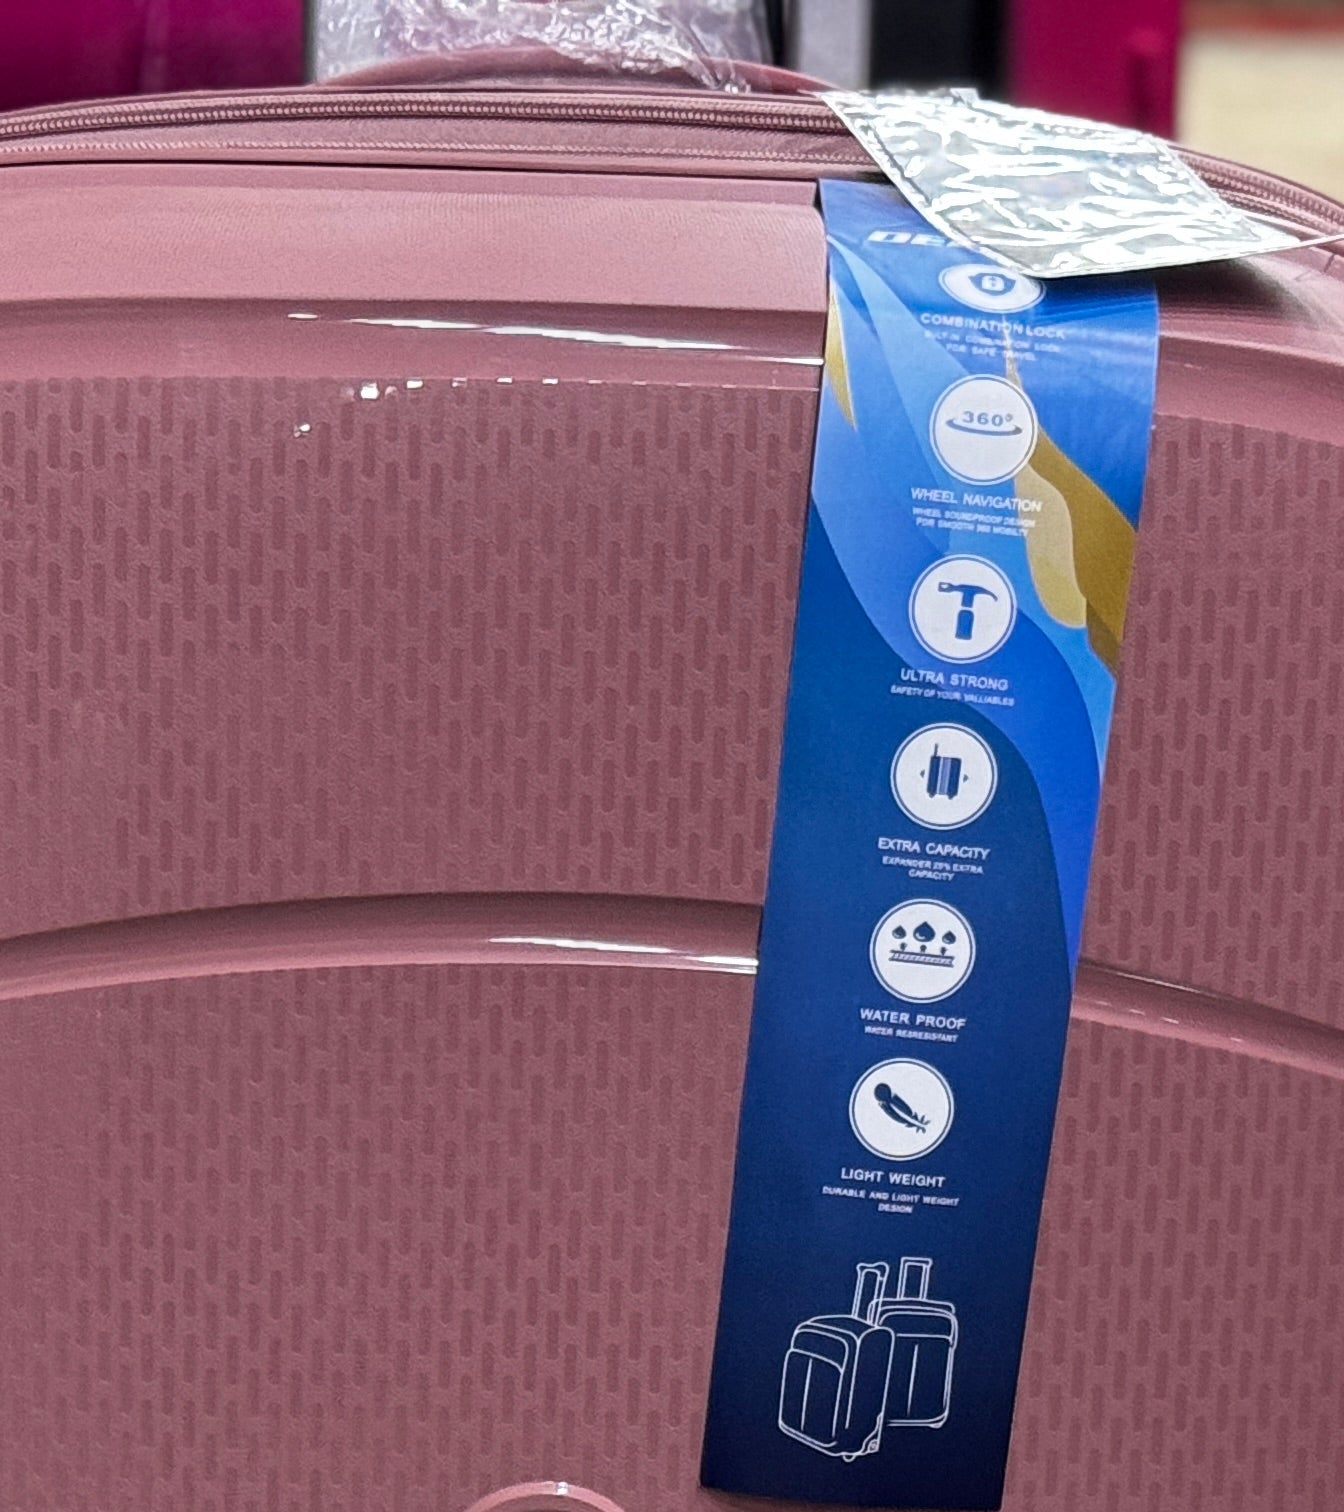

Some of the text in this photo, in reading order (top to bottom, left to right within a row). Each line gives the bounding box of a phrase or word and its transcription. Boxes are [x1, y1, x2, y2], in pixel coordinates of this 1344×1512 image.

[920, 312, 1066, 340] COMBINATION LOCK
[911, 487, 1043, 512] WHEEL NAVIGATION
[916, 516, 935, 527] FOR
[900, 667, 1009, 691] ULTRA STRONG
[890, 684, 923, 697] SAFETY
[924, 688, 936, 698] OF
[937, 690, 962, 701] YOUR
[878, 837, 991, 860] EXTRA CAPACITY
[882, 855, 932, 870] EXPANDER
[952, 863, 984, 875] EXTRA
[908, 869, 955, 881] CAPACITY
[860, 1007, 967, 1030] WATER PROOF
[864, 1025, 894, 1036] WATER
[841, 1167, 946, 1188] LIGHT WEIGHT
[822, 1186, 960, 1207] DURABLE AND LIGHT WEIGHT
[877, 1203, 913, 1214] DESIGN
